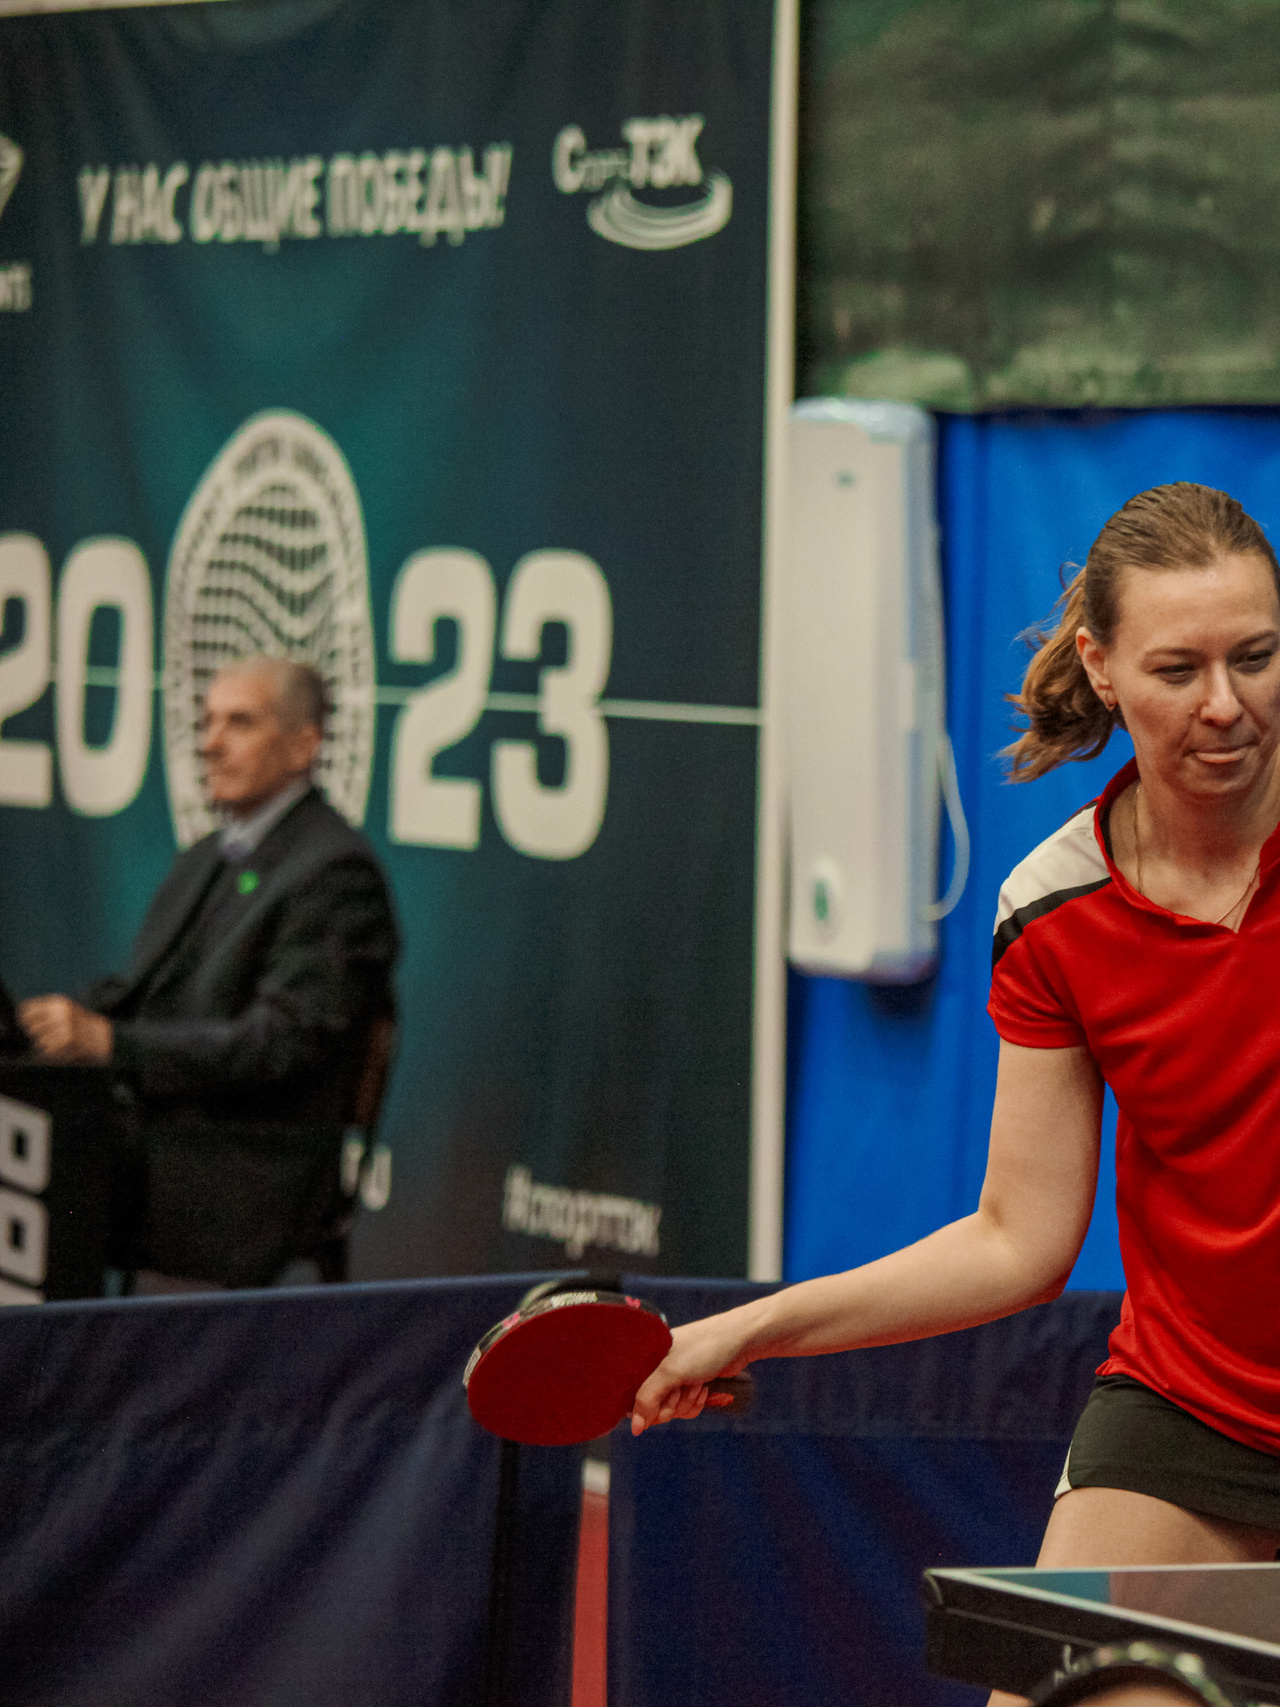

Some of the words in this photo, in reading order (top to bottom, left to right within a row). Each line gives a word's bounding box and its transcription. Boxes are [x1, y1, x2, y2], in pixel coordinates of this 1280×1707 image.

[78, 163, 110, 245] У
[109, 161, 189, 245] НАС
[190, 154, 323, 254] ОБЩИЕ
[327, 141, 513, 248] ПОБЕДЫ!
[388, 545, 614, 861] 23
